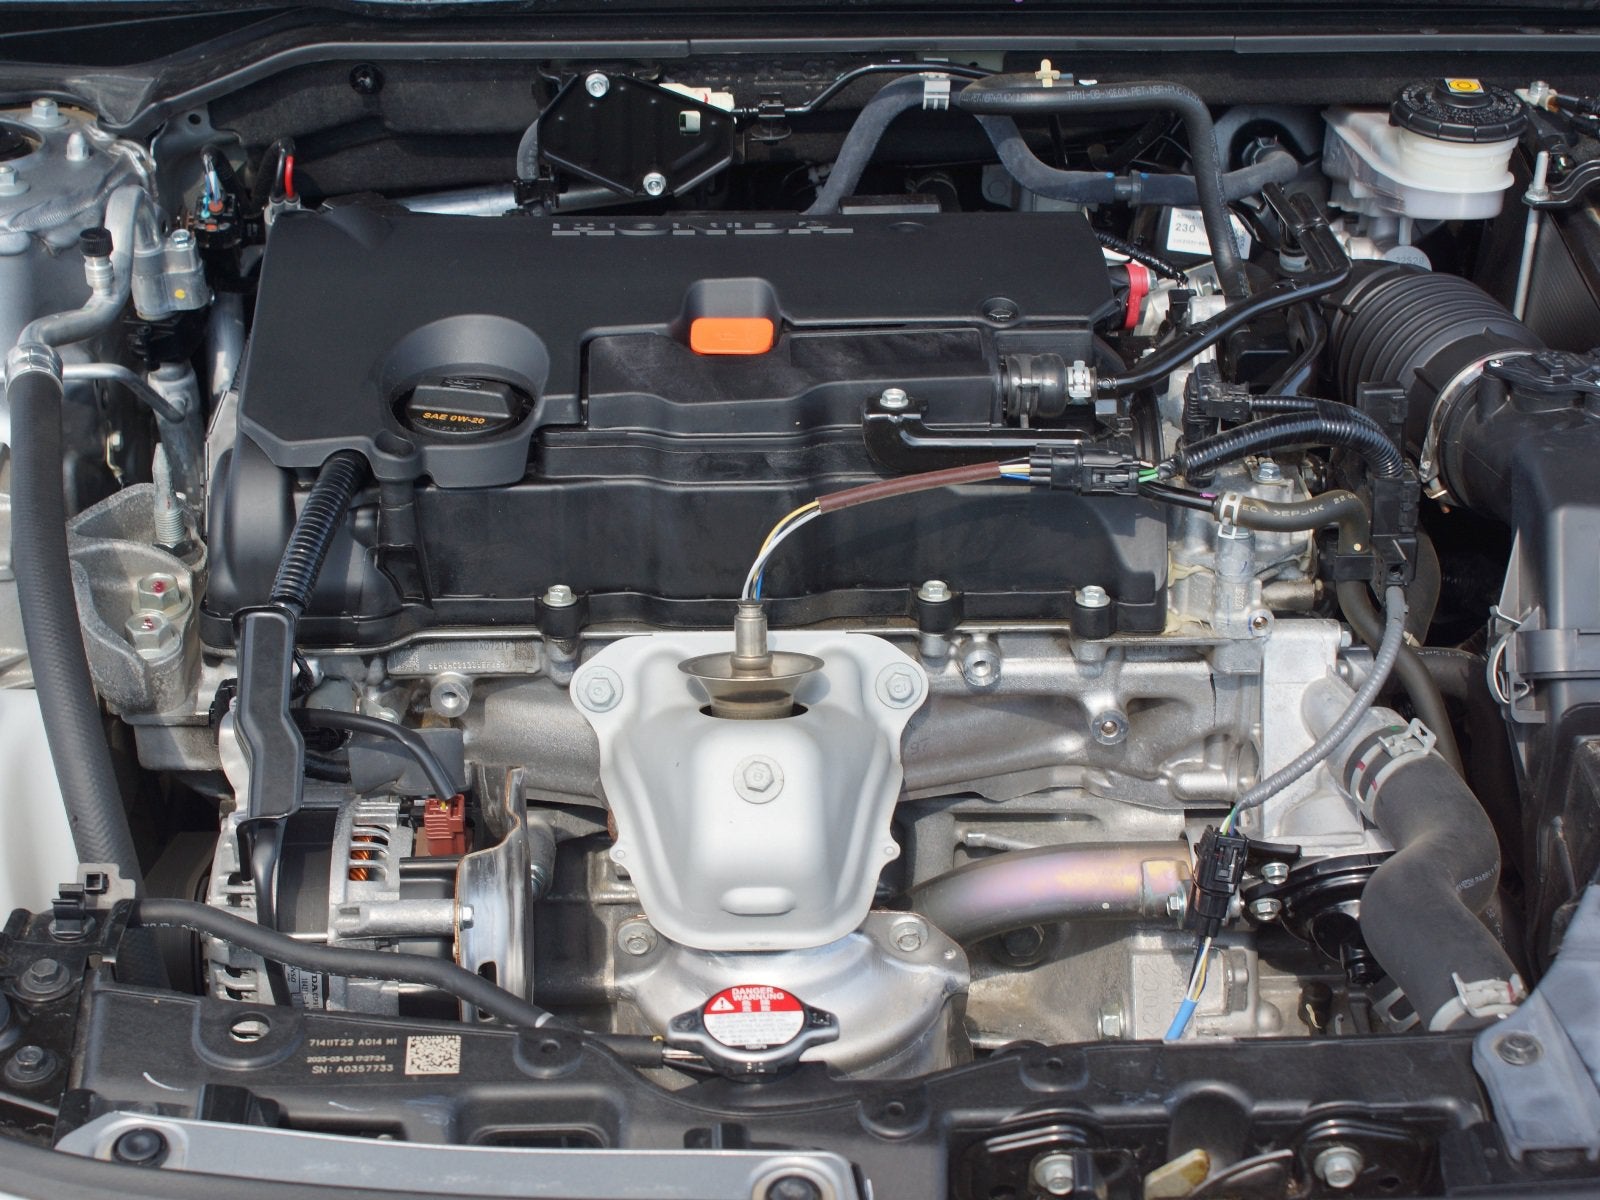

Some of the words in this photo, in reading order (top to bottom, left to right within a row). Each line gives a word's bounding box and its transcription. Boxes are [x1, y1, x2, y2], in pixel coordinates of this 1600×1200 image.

[1175, 223, 1196, 233] 230
[422, 412, 447, 421] SAE
[449, 415, 485, 424] 0W-20
[731, 987, 774, 996] DANGER
[732, 992, 785, 1001] WARNUNG
[312, 1065, 334, 1074] SN:
